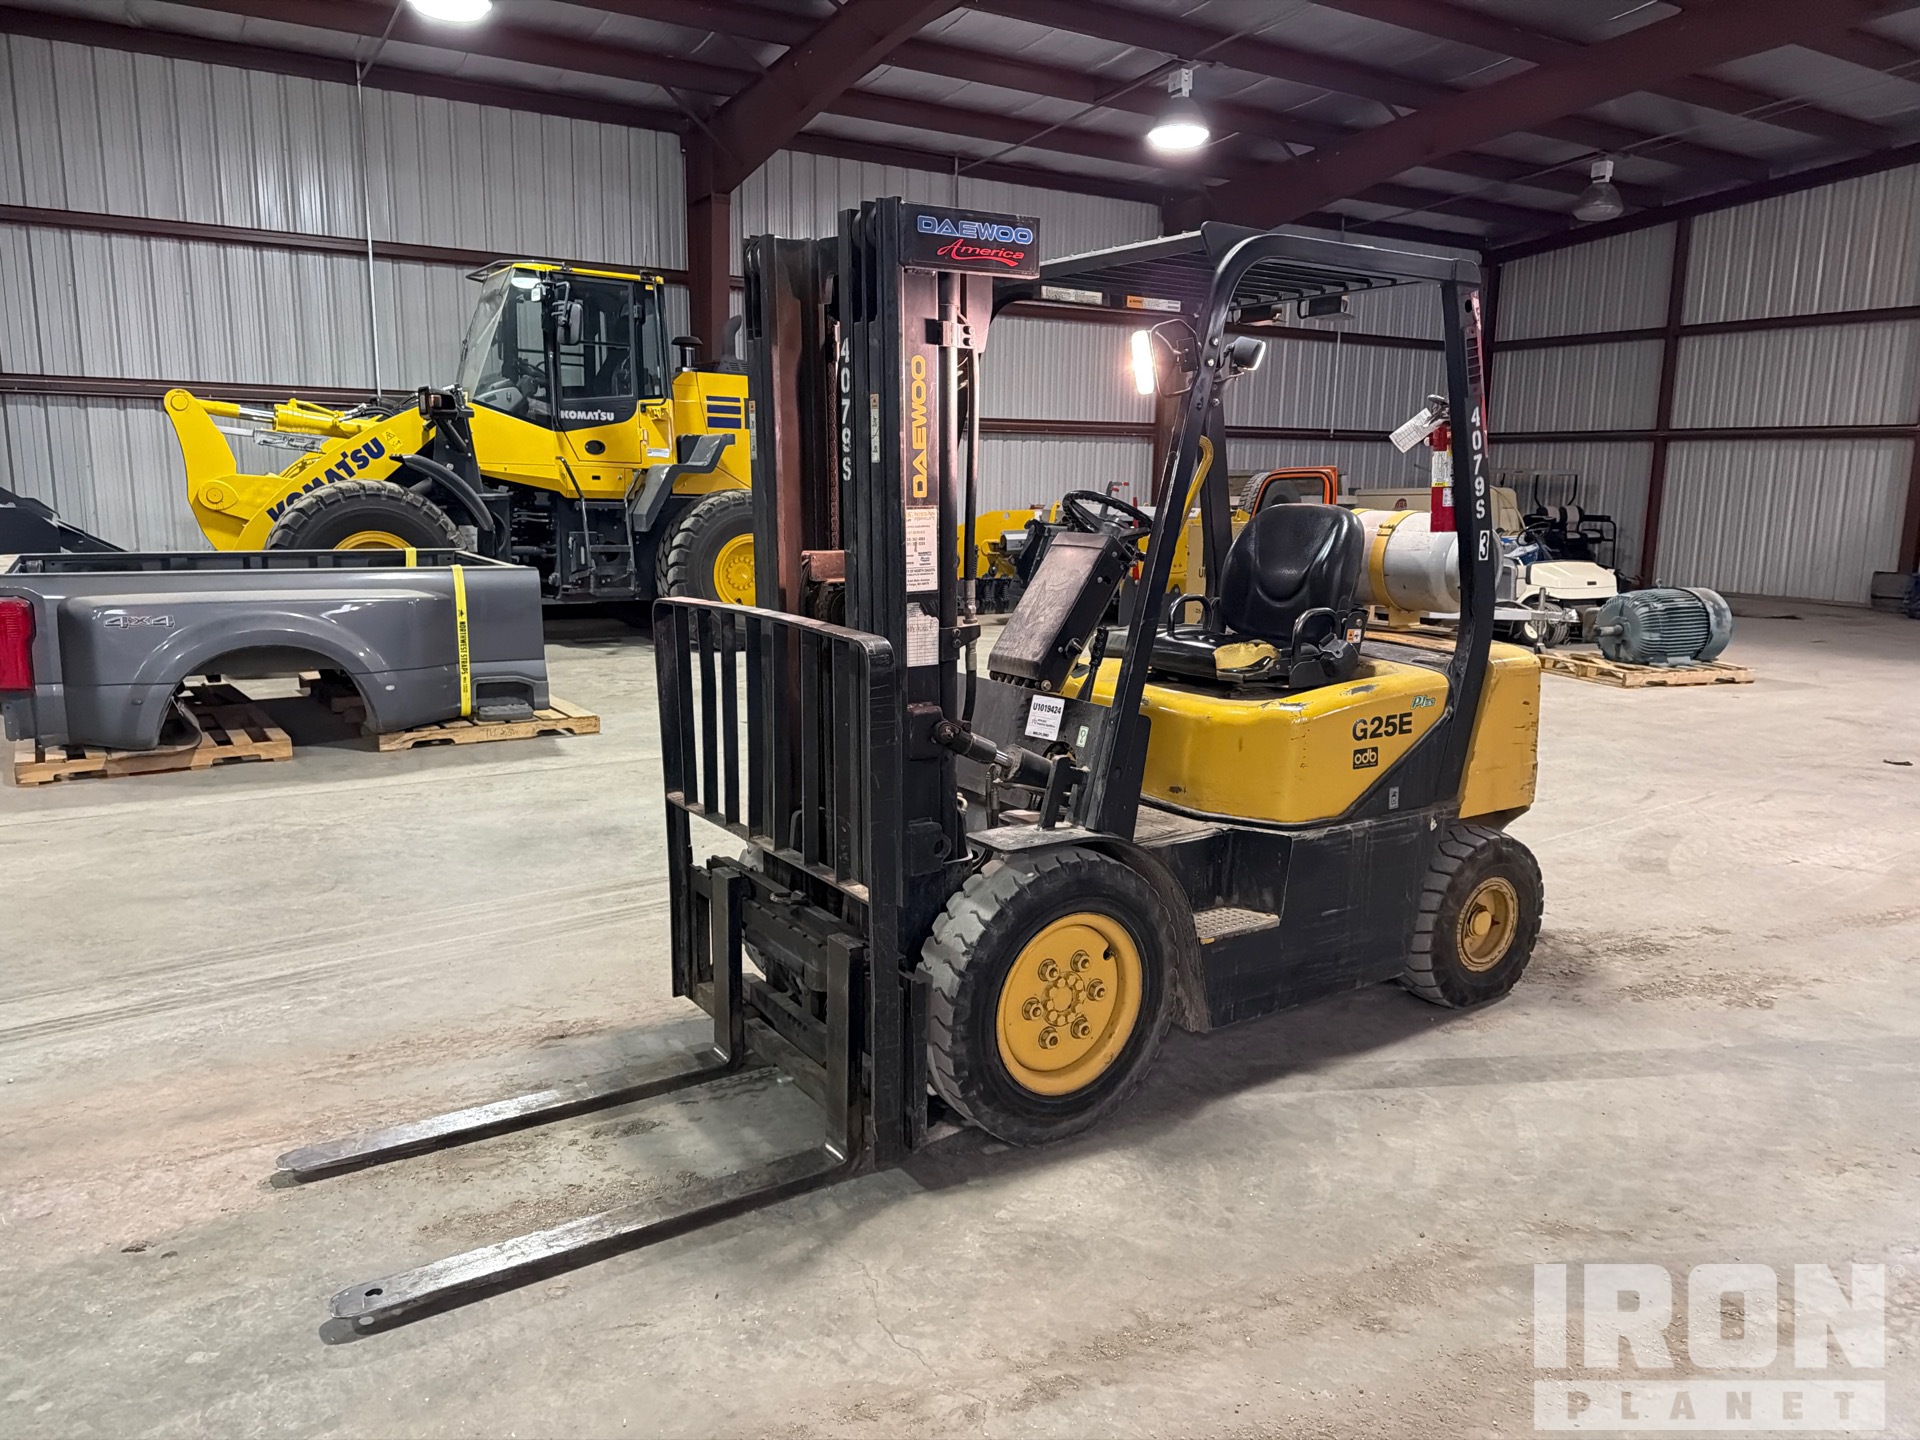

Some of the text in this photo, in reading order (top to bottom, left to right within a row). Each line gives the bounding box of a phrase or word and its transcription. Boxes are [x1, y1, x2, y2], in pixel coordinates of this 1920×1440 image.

[917, 215, 1033, 245] DAEWOO
[936, 238, 1025, 265] America
[560, 409, 615, 421] KOMATSU
[911, 354, 928, 498] DAEWOO
[1471, 406, 1486, 519] 4079S
[1479, 532, 1488, 559] 3
[1032, 702, 1062, 715] U1019424
[1352, 712, 1413, 741] G25E
